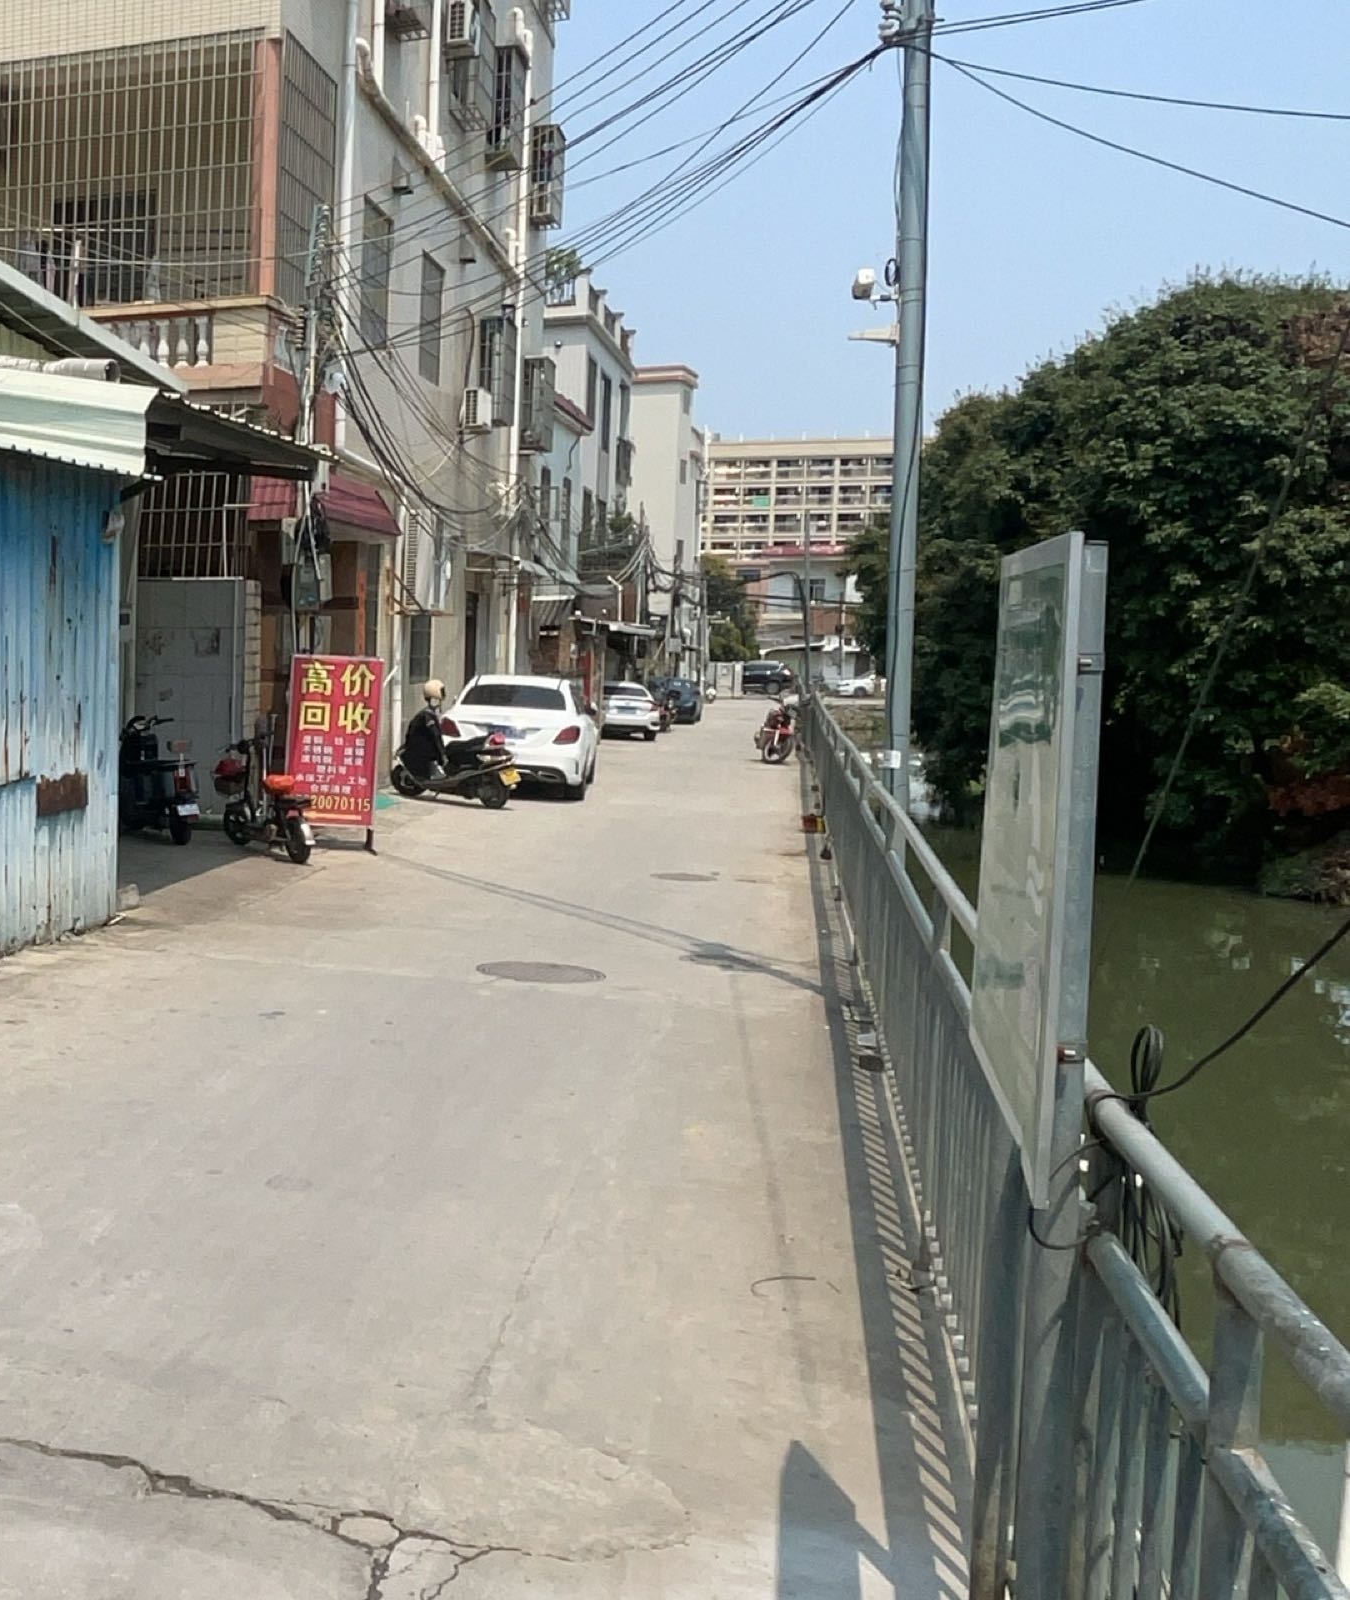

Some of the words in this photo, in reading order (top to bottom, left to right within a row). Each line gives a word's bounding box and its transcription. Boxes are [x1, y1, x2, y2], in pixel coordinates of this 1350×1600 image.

[301, 662, 375, 697] 高价
[299, 702, 374, 734] 回收
[310, 794, 371, 812] 20070115
